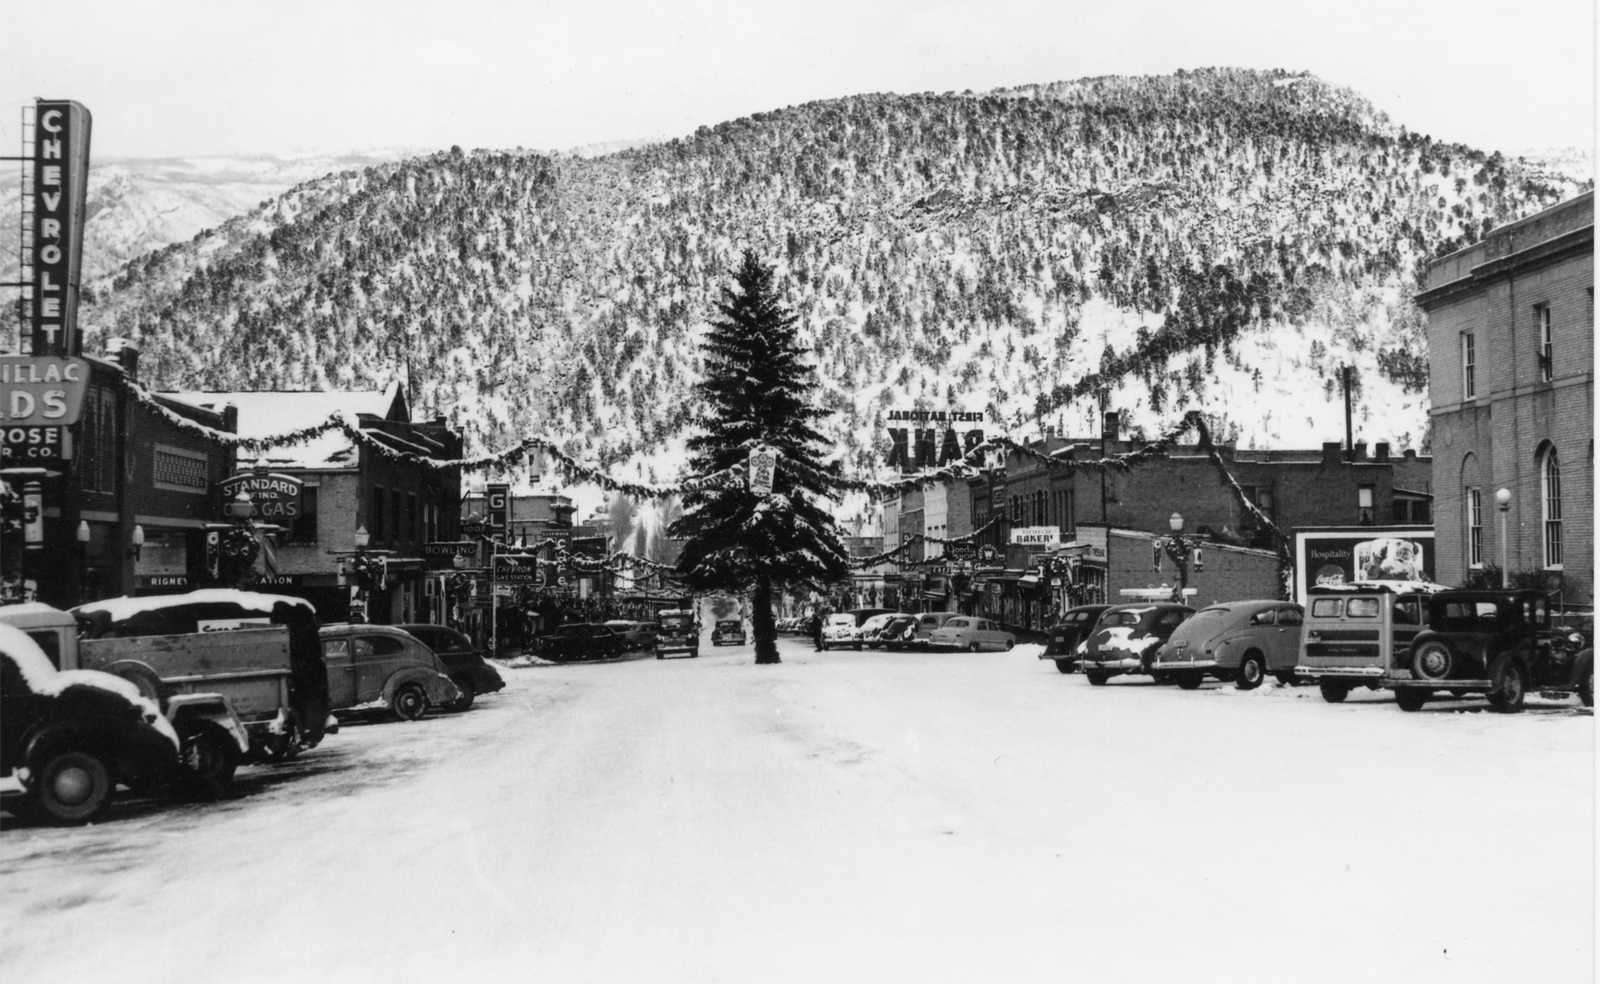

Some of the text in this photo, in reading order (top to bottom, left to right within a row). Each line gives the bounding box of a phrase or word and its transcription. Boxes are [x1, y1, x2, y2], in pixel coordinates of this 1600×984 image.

[41, 109, 63, 344] CHEVROLET
[0, 390, 67, 419] DS
[223, 479, 298, 497] STANDARD
[262, 501, 297, 517] GAS
[1310, 549, 1351, 560] Hospitality
[496, 565, 532, 574] CHEVRON
